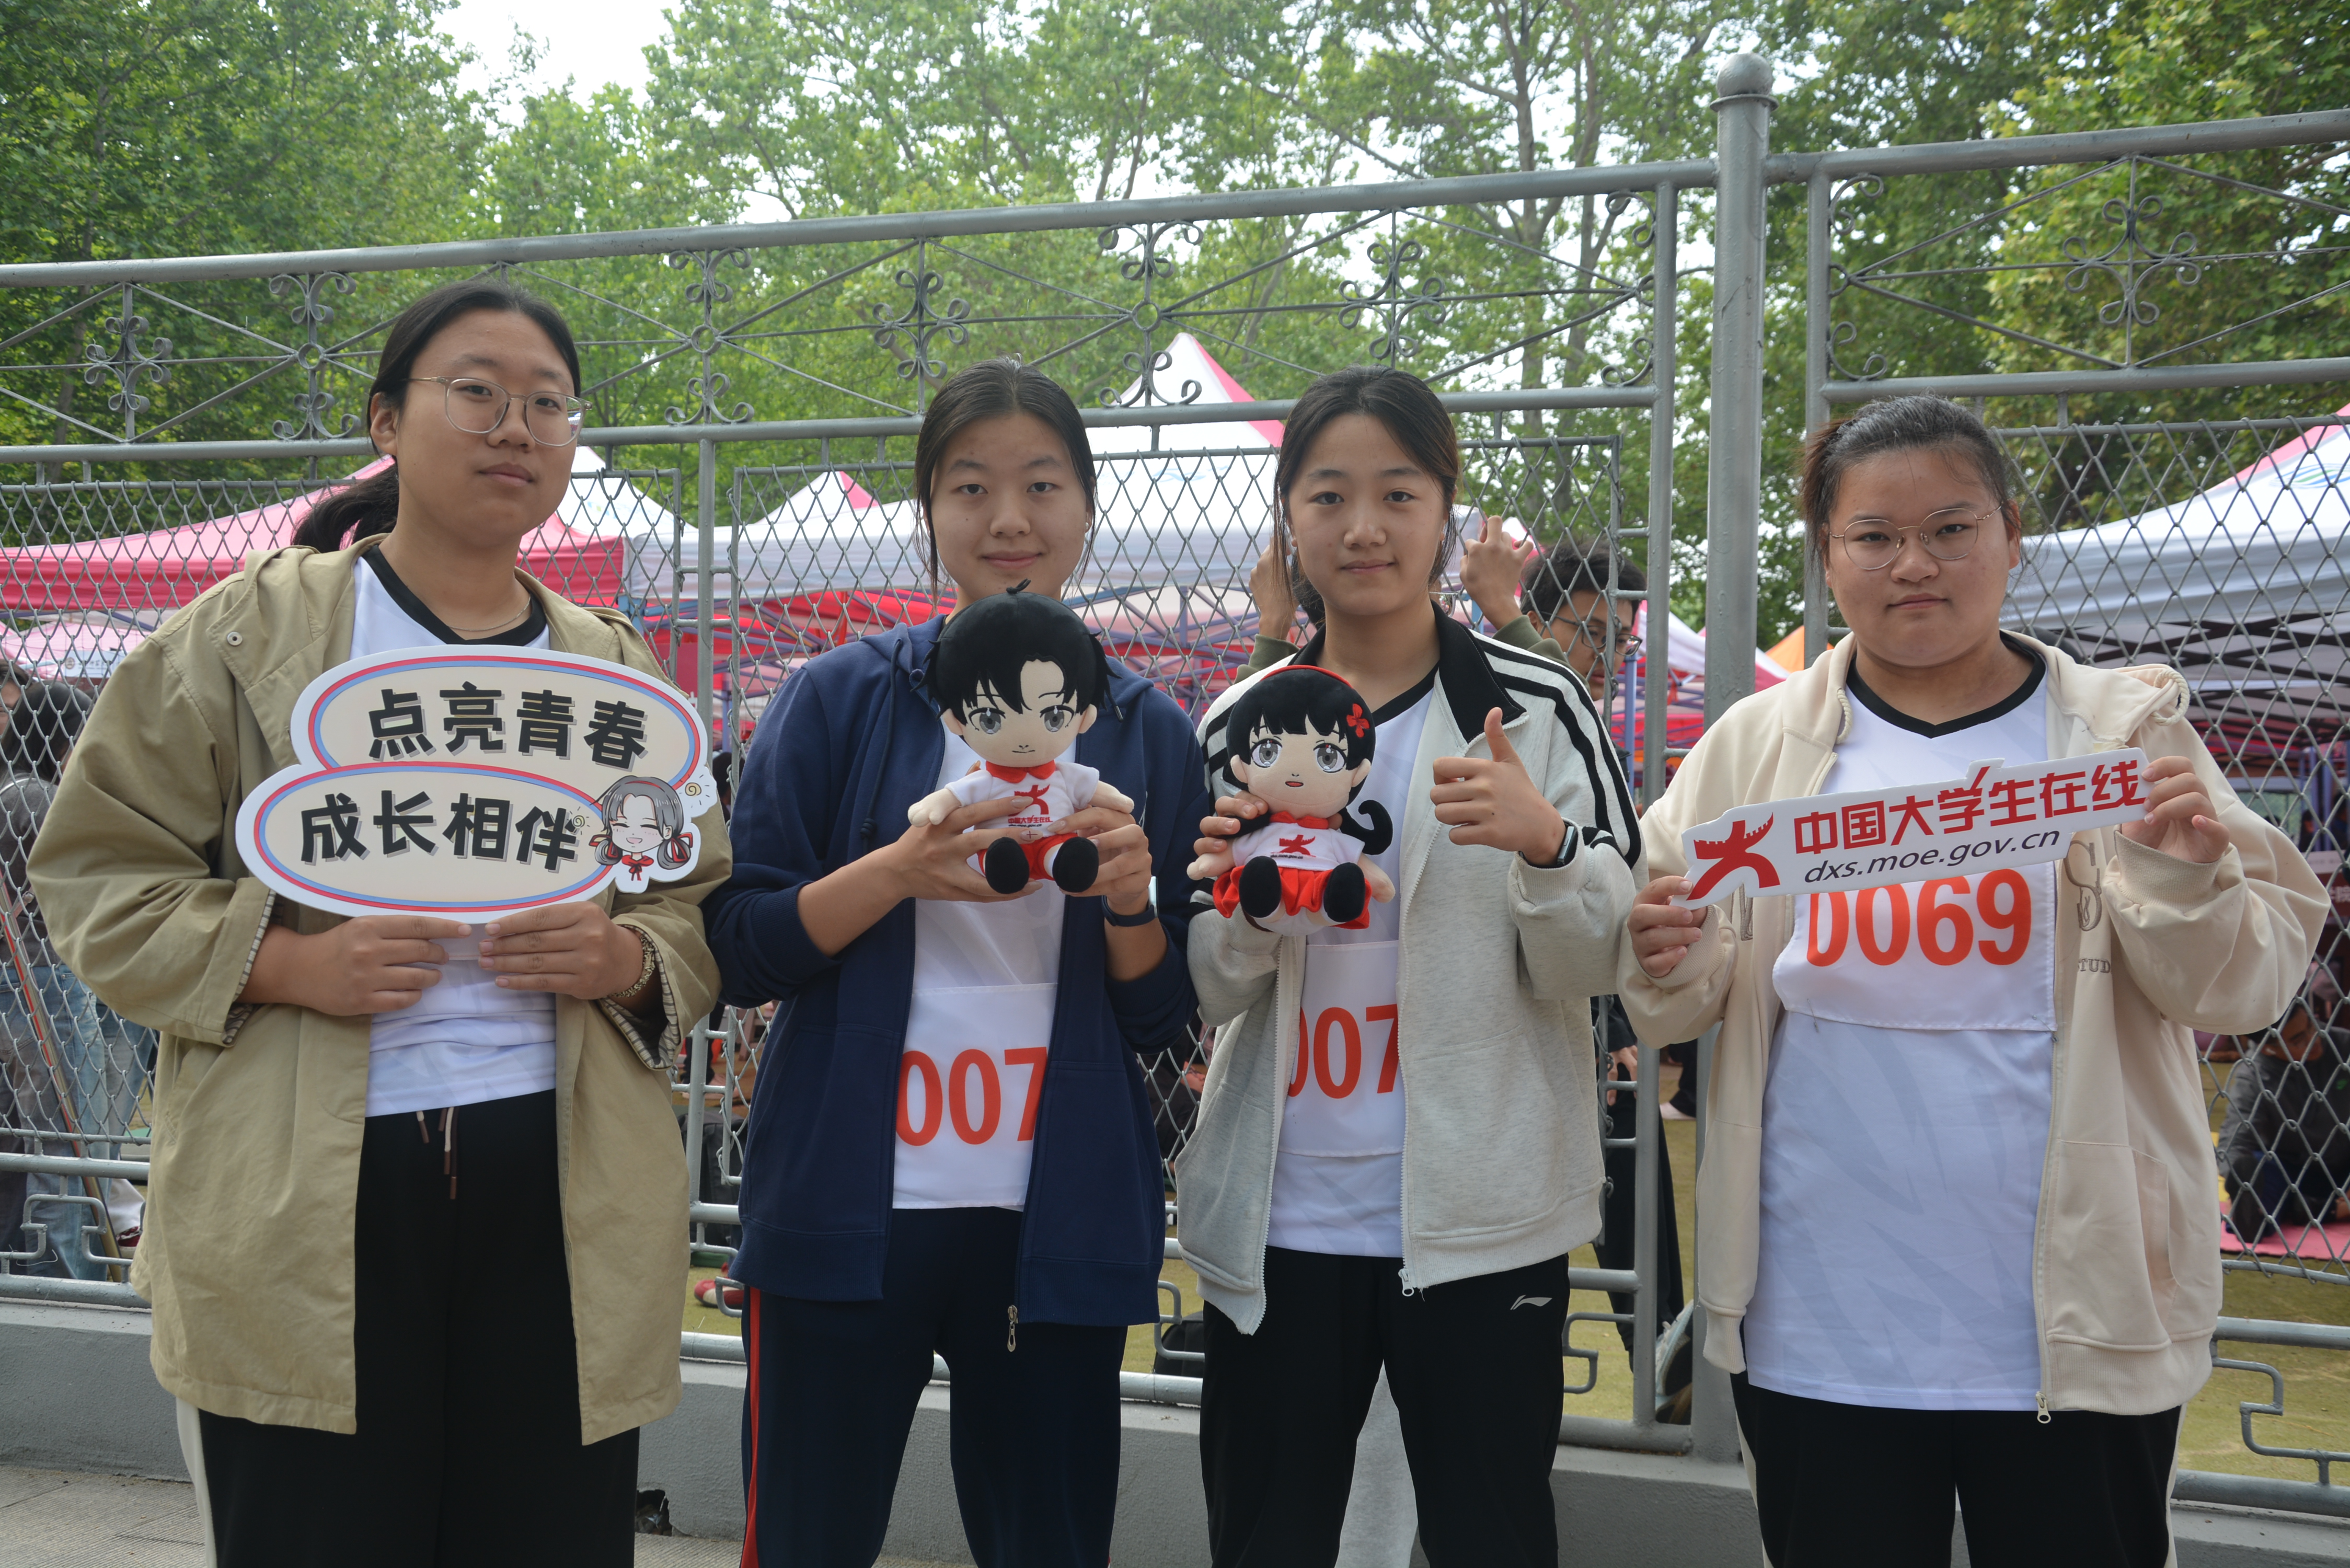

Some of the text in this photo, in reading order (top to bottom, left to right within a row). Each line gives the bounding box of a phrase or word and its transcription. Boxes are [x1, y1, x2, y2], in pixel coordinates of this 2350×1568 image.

[369, 682, 648, 770] 点亮青春
[302, 790, 578, 872] 成长相伴
[1794, 759, 2147, 854] 中国大学生在线
[1804, 829, 2060, 884] dxs.moe.gov.cn
[1806, 868, 2031, 966] 0069
